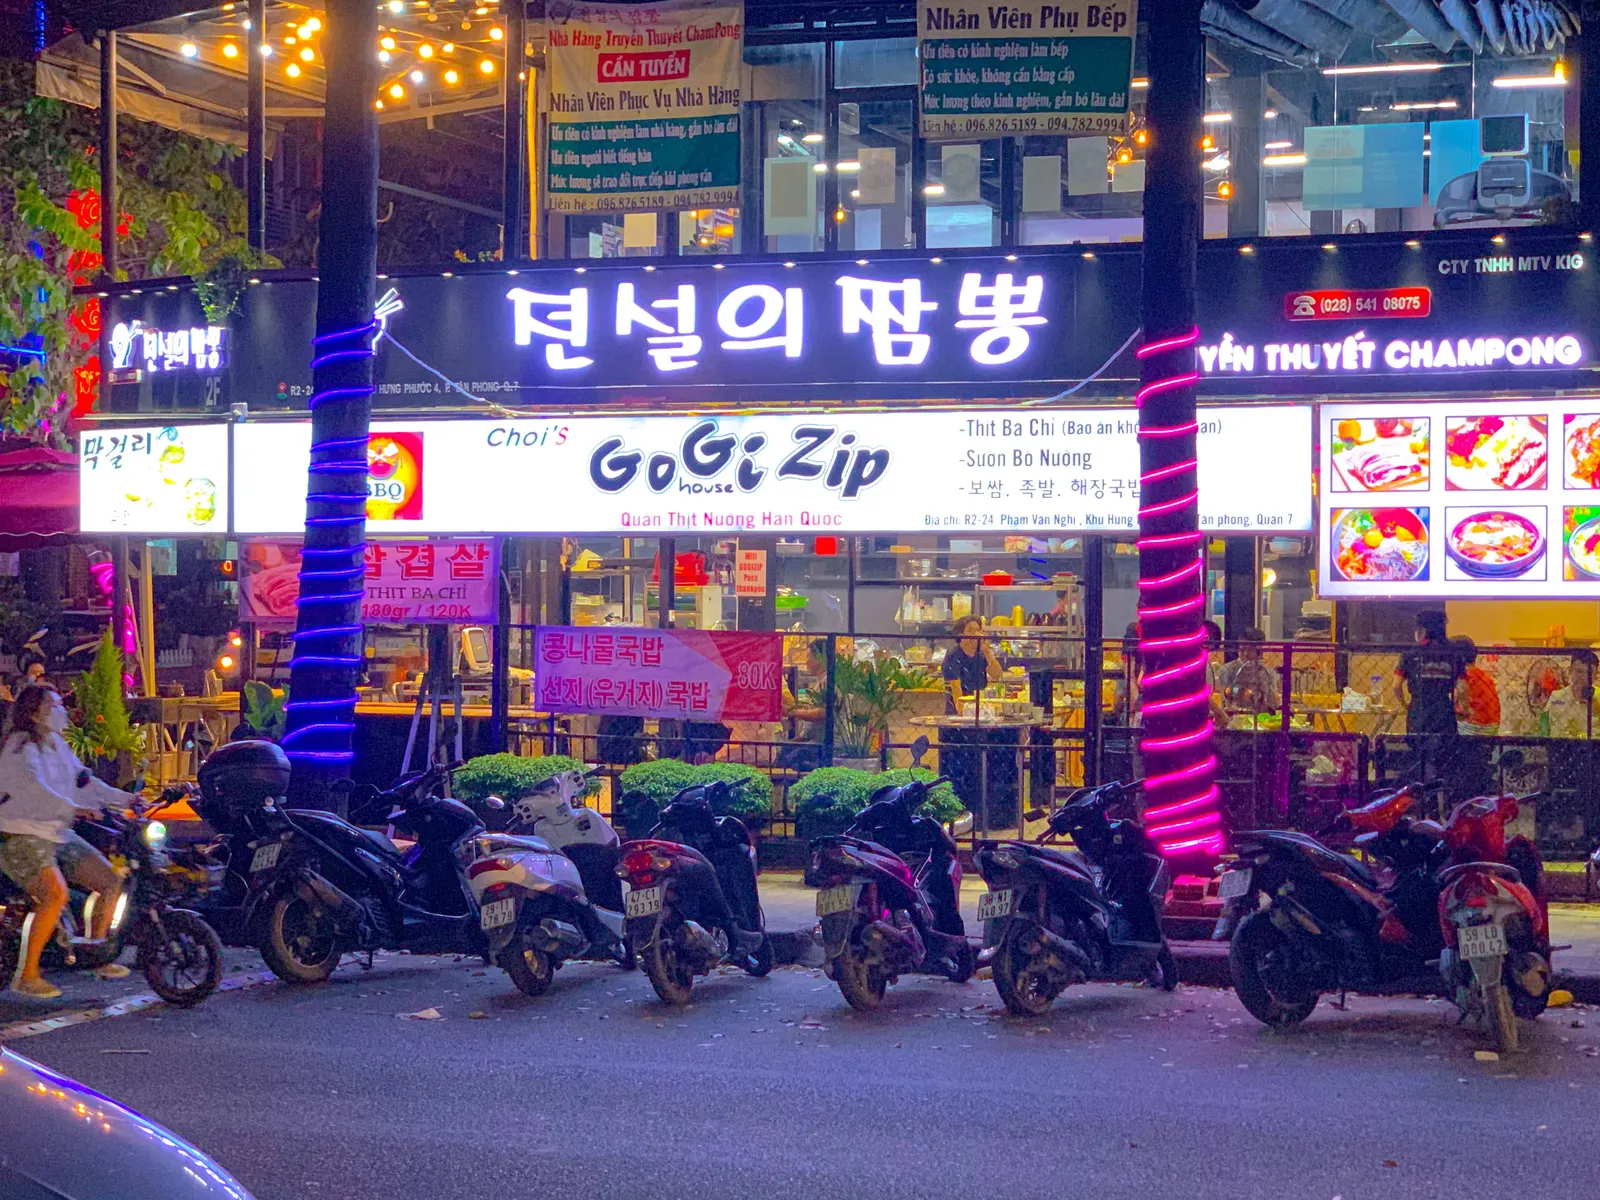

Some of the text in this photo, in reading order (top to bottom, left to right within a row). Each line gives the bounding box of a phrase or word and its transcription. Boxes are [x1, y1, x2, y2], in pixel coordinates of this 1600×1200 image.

[926, 3, 1127, 33] Nhân Viên Phụ Bếp
[550, 85, 740, 114] Nhân Viên Phục Vụ Nhà Hàng
[966, 118, 1036, 132] 096.826.5189
[1047, 117, 1125, 132] 094.782.9994
[597, 196, 664, 210] 096.826.5189
[1438, 254, 1584, 274] CTY TNHH MTV KIG
[1320, 296, 1421, 314] (028) 541 08075
[506, 272, 1049, 372] 전설의 짬뽕
[1194, 330, 1581, 372] YỀN THUYẾT CHAMPONG
[206, 377, 221, 405] 2F
[472, 382, 498, 393] PHONG
[1002, 419, 1022, 437] Ba
[1062, 421, 1092, 437] (Bao
[1200, 419, 1222, 435] an)
[84, 432, 151, 470] 막걸리
[588, 420, 890, 498] GoGi Zip
[679, 477, 734, 494] house
[965, 514, 994, 525] R2-24
[1085, 513, 1104, 525] Khu
[1288, 513, 1293, 525] 7
[367, 584, 467, 602] THỊT BA CHỈ
[362, 603, 472, 620] 180gr 120K
[543, 632, 664, 665] 콩나물국밥
[738, 661, 777, 690] 80K
